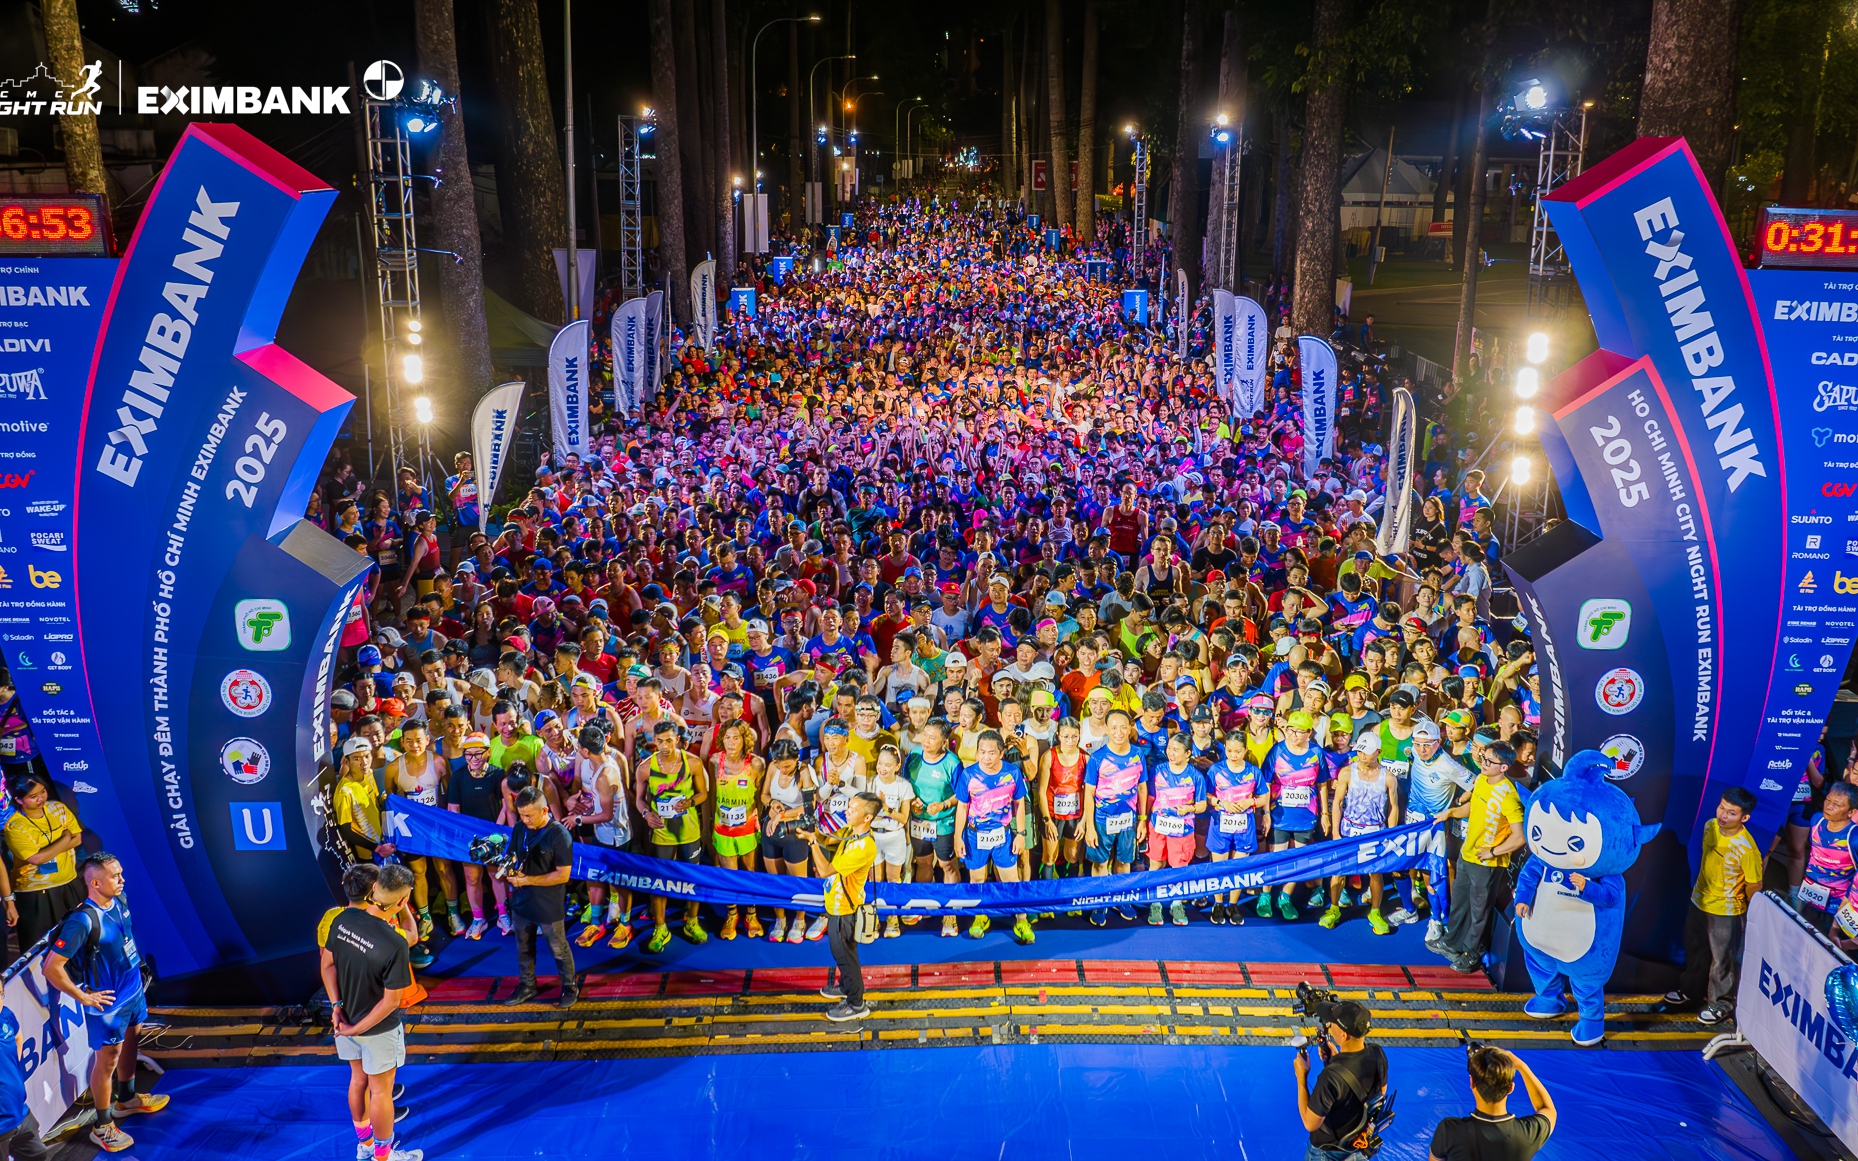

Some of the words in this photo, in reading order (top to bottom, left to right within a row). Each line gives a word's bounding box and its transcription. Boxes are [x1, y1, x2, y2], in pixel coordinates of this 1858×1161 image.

[96, 184, 240, 488] EXIMBANK
[627, 315, 636, 373] EXIMBANK
[1246, 314, 1256, 371] EXIMBANK
[1633, 196, 1767, 493] EXIMBANK
[565, 356, 580, 446] EXIMBANK
[1627, 389, 1650, 418] HO
[190, 385, 248, 481] EXIMBANK
[1644, 419, 1667, 452] CHI
[225, 411, 287, 508] 2025
[1590, 415, 1650, 508] 2025
[1657, 451, 1686, 501] MINH
[26, 505, 65, 514] WAKE-UP
[173, 481, 201, 532] MINH
[1676, 503, 1698, 542] CITY
[1791, 515, 1832, 524] SUUNTO
[164, 530, 185, 567] CHÍ
[1792, 552, 1830, 560] ROMANO
[28, 564, 62, 588] be
[157, 569, 176, 600] HỒ
[1686, 545, 1708, 600] NIGHT
[152, 600, 171, 644] PHỐ
[1695, 604, 1712, 644] RUN
[149, 646, 169, 712] THÀNH
[313, 583, 359, 763] EXIMBANK
[1526, 592, 1565, 770] EXIMBANK
[1693, 648, 1712, 742] EXIMBANK
[153, 716, 174, 757] ĐÊM
[160, 760, 183, 810] CHẠY
[1285, 792, 1309, 800] 20306
[170, 813, 194, 850] GIẢI
[721, 812, 745, 820] 21135
[587, 867, 697, 896] EXIMBANK
[1156, 871, 1265, 899] EXIMBANK
[1801, 887, 1824, 902] 51620
